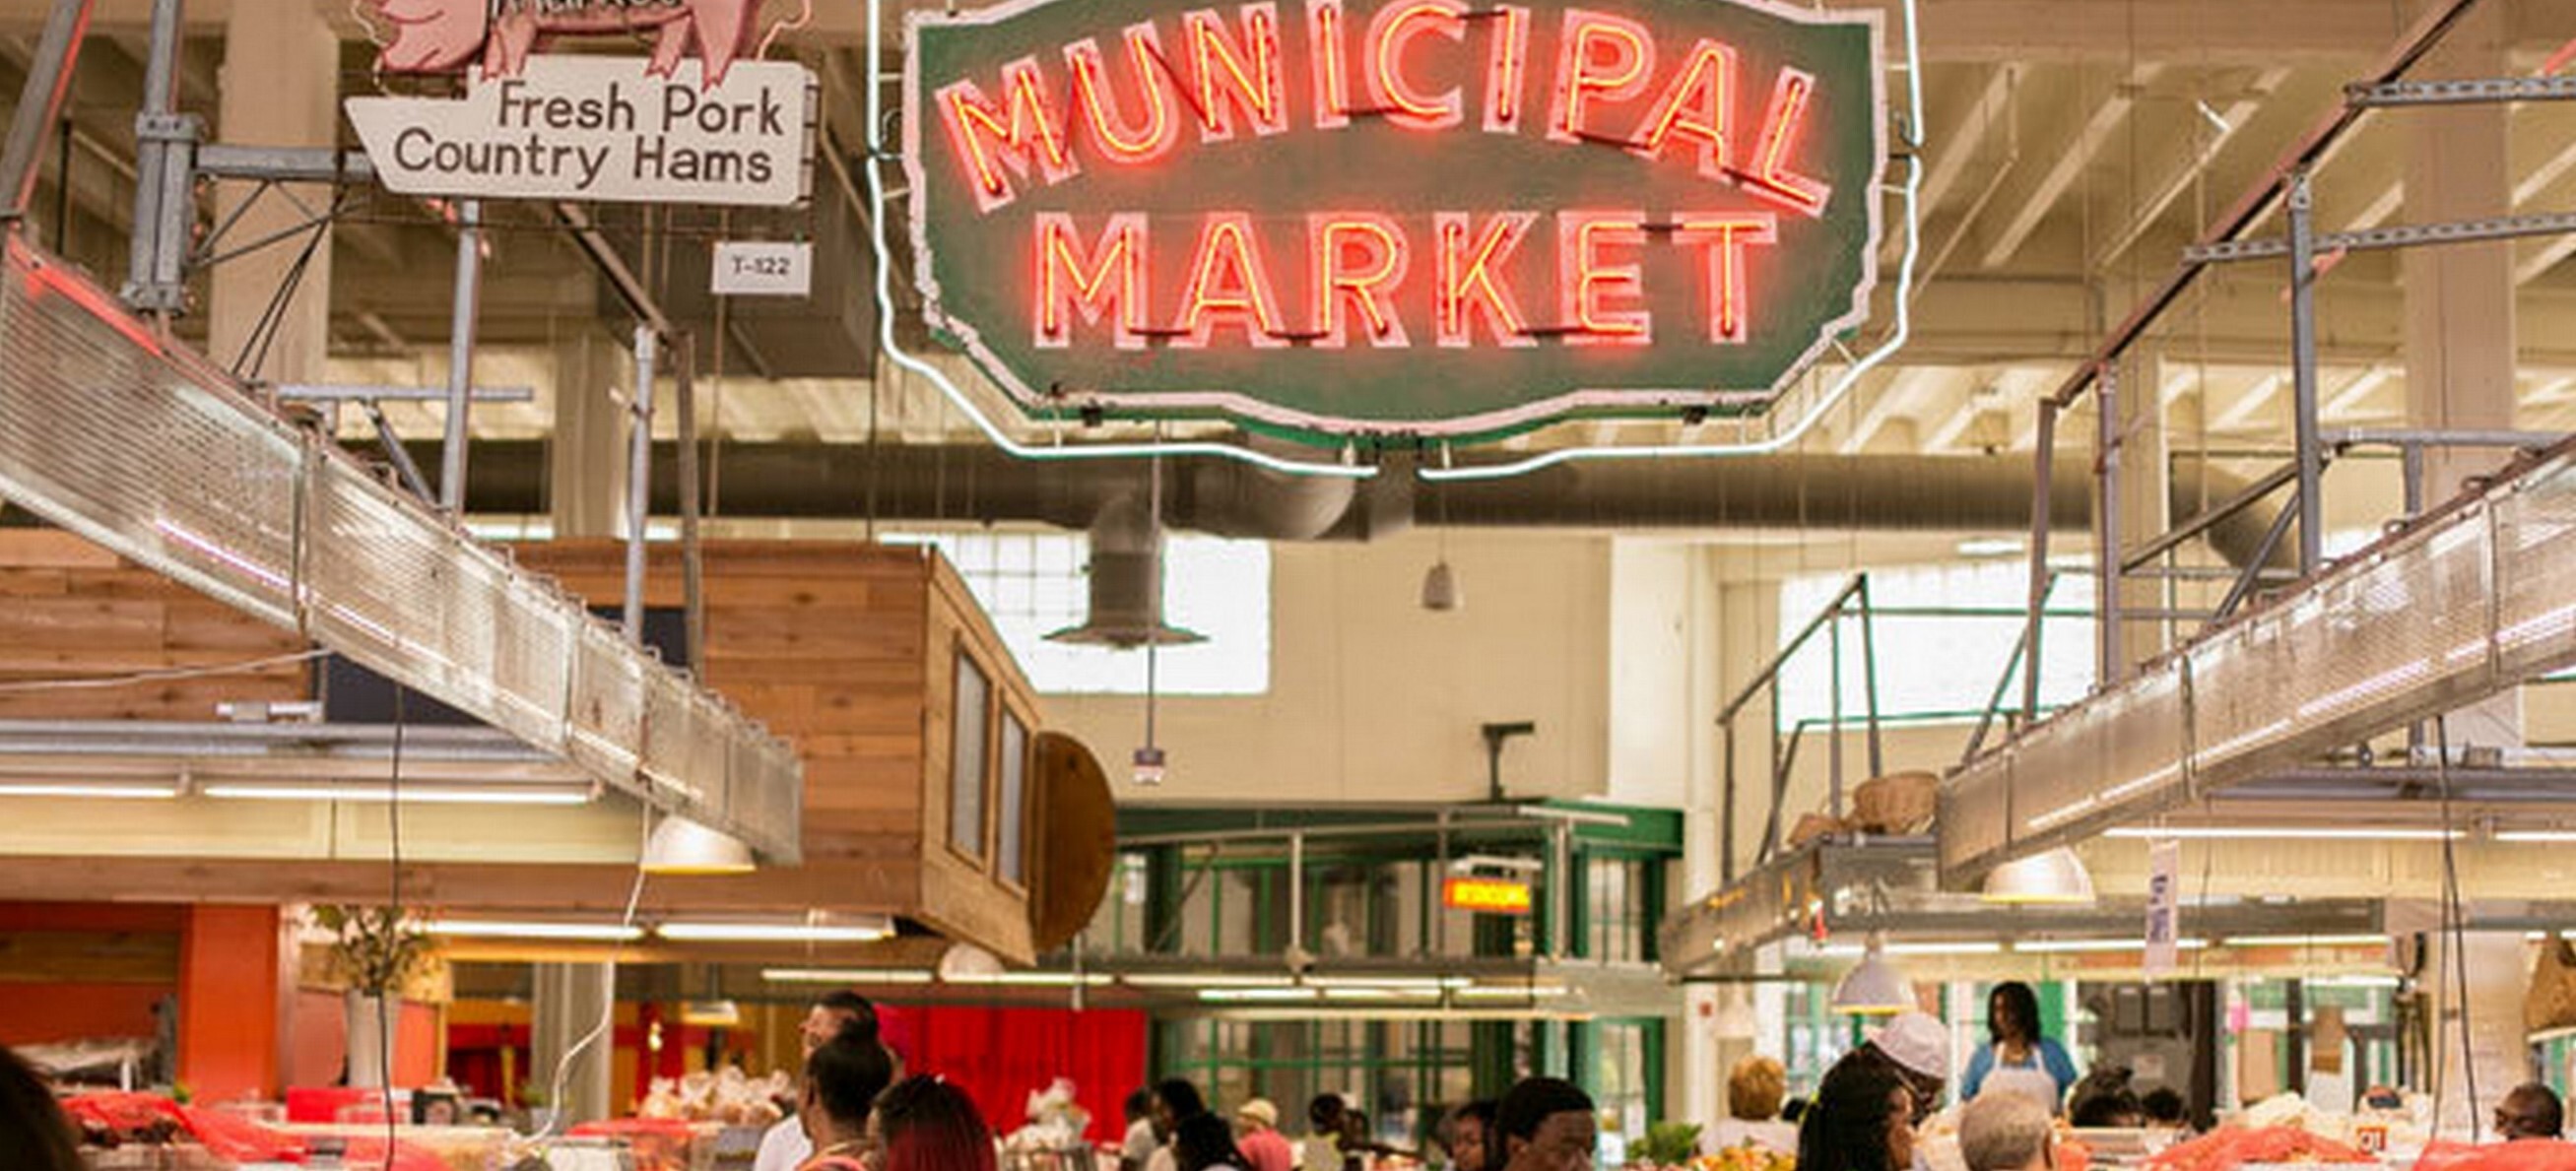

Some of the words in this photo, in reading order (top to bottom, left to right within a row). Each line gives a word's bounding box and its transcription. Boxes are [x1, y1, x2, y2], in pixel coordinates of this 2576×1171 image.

[496, 81, 634, 132] Fresh
[663, 85, 784, 136] Pork
[934, 0, 1831, 218] MUNICIPAL
[395, 128, 610, 190] Country
[633, 136, 773, 182] Hams
[733, 256, 791, 275] T-122
[1034, 211, 1776, 349] MARKET
